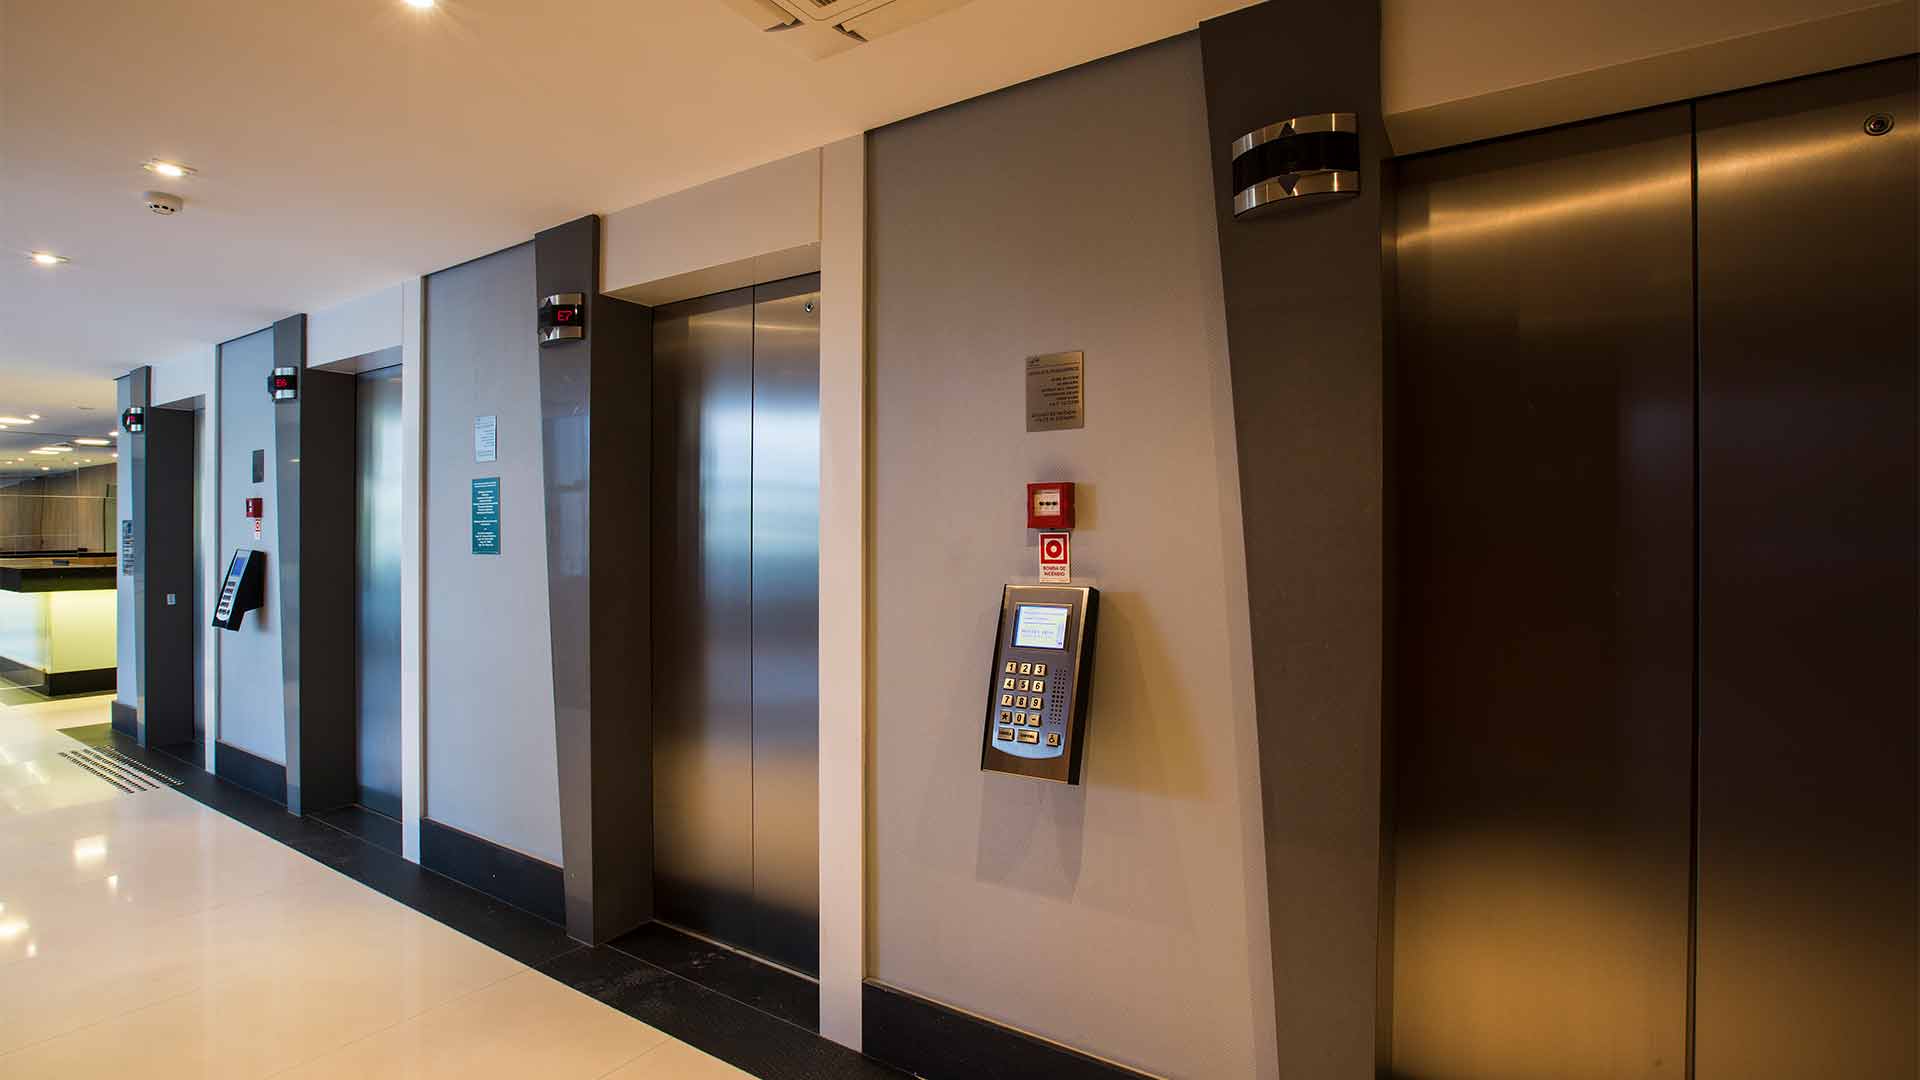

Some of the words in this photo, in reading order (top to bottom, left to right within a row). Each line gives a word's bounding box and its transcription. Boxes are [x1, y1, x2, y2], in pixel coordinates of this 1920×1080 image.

[558, 310, 573, 320] E7
[1022, 665, 1028, 673] 2
[1037, 666, 1043, 674] 3
[1035, 682, 1041, 690] 6
[1004, 696, 1010, 704] 7
[1018, 698, 1024, 706] 8
[1033, 698, 1039, 707] 9
[1016, 714, 1022, 722] 0
